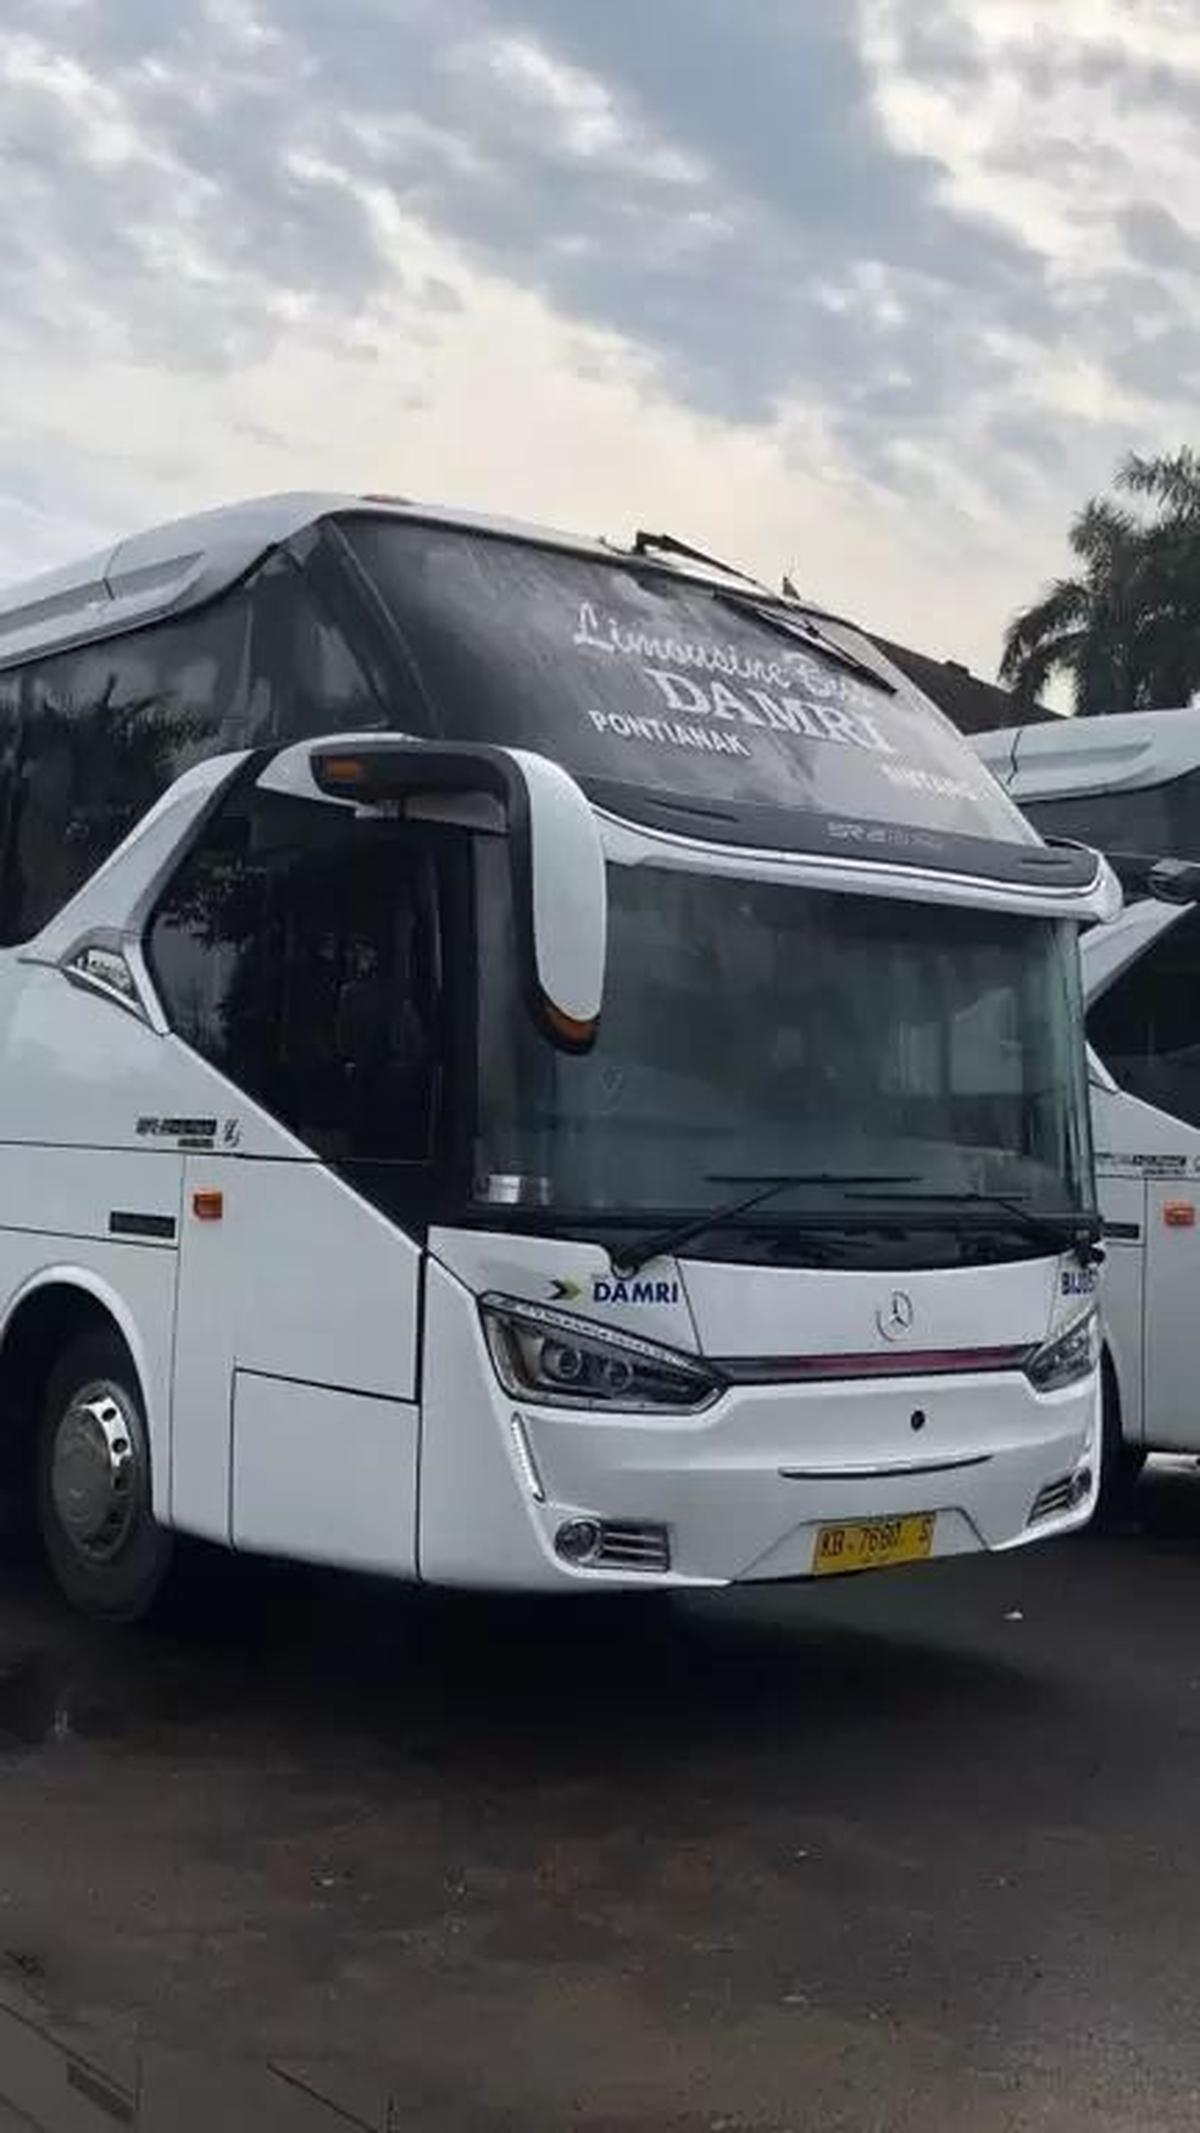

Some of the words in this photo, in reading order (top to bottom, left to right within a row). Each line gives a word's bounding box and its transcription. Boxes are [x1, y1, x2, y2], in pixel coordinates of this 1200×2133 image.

[573, 601, 792, 689] Limousine
[588, 710, 751, 757] PONTIANAK
[645, 668, 897, 754] DAMRI
[593, 1282, 679, 1303] DAMRI
